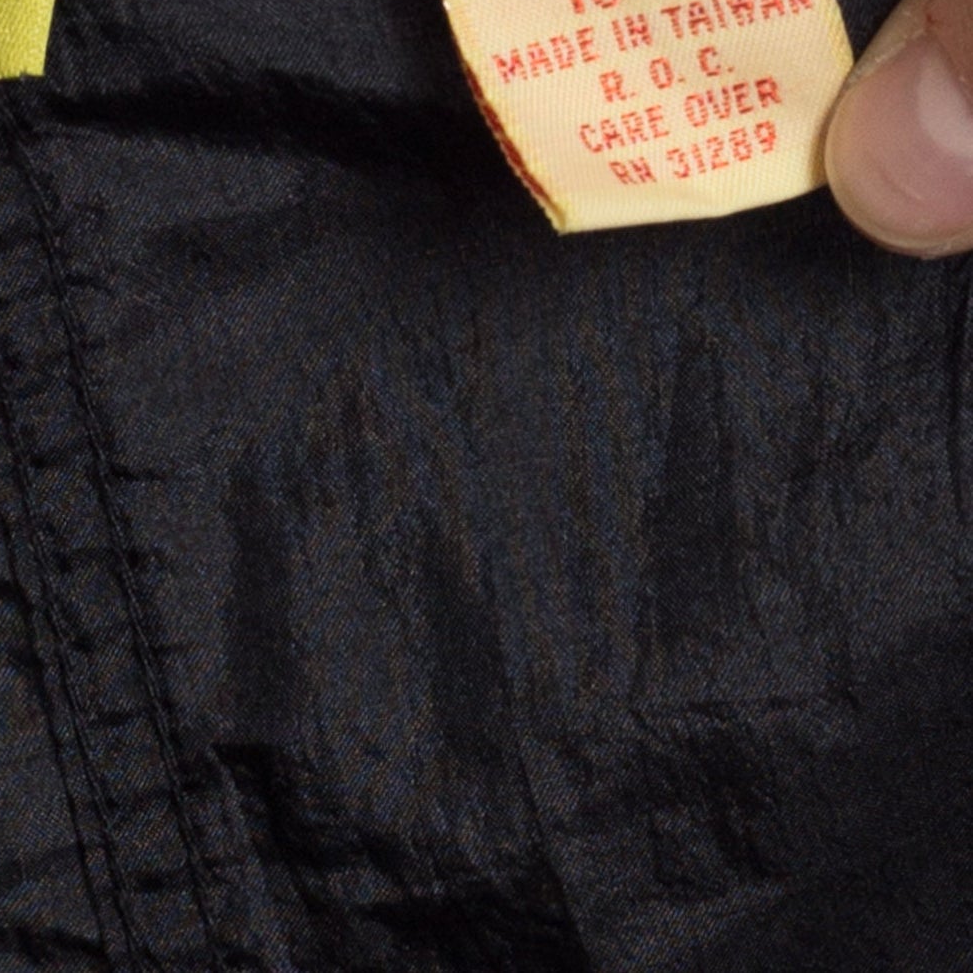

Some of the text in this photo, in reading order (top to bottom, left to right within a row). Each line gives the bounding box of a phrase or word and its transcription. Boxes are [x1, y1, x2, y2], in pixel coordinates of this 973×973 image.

[492, 27, 599, 84] MADE
[611, 13, 654, 51] IN
[599, 46, 734, 103] R. O. C.
[579, 75, 783, 154] CARE OVER
[608, 120, 778, 185] RN 31289
